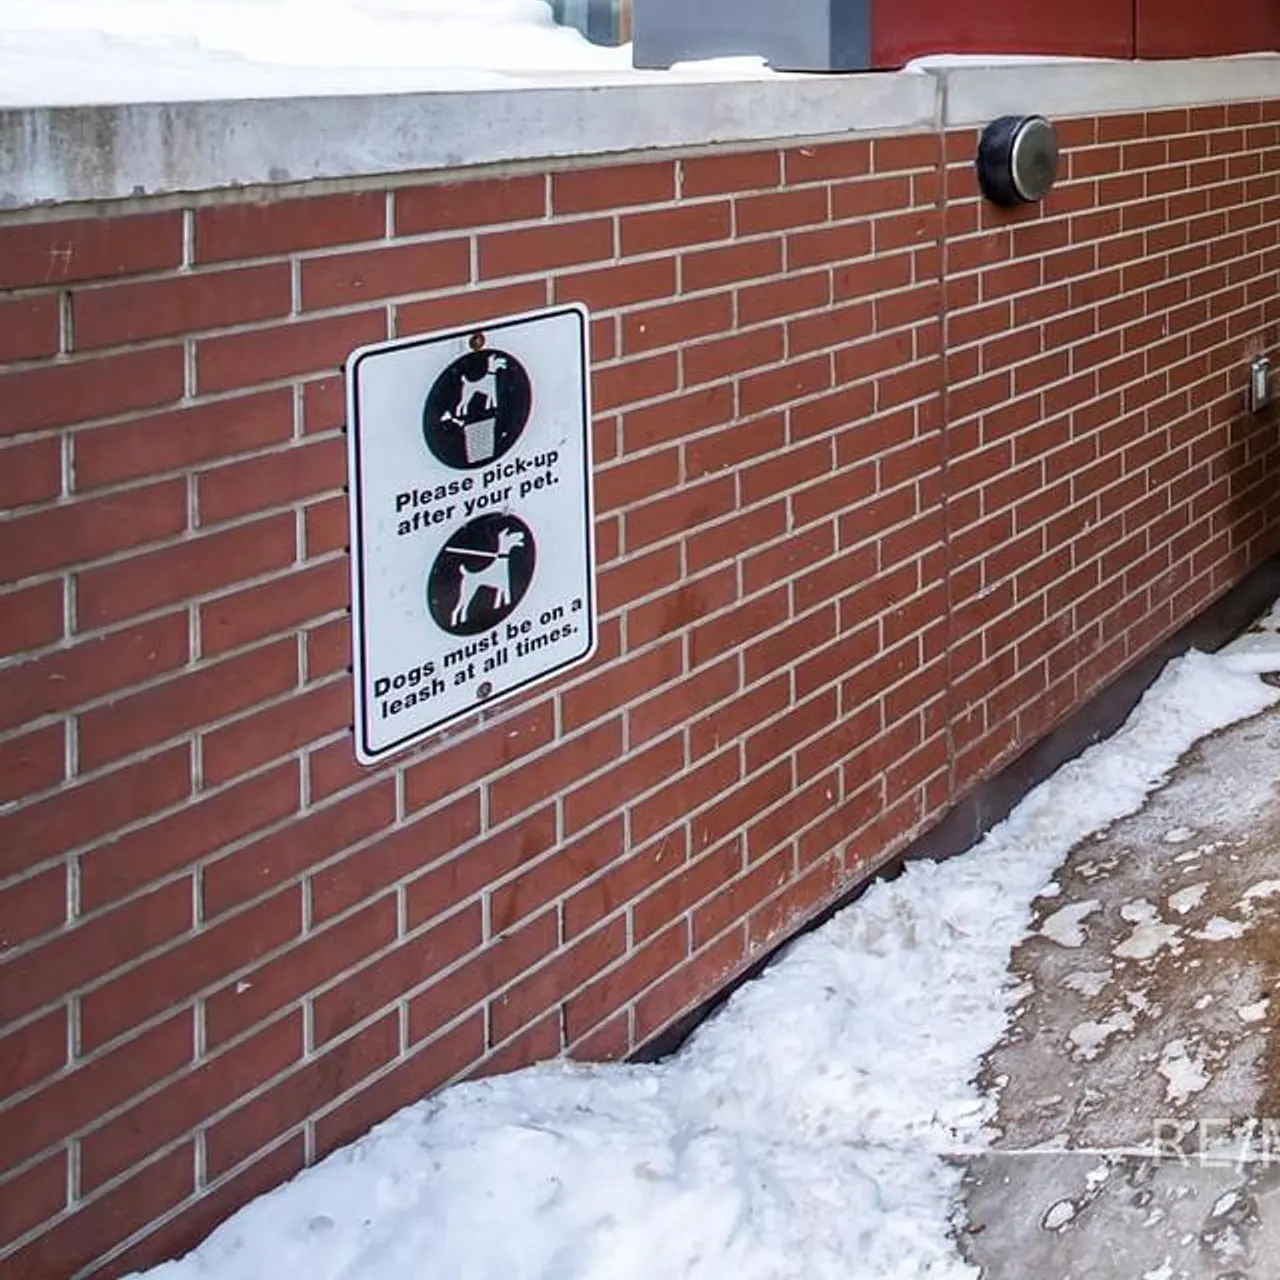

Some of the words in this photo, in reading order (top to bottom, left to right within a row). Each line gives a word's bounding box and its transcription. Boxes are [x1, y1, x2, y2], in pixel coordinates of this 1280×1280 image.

[396, 477, 474, 513] Please
[482, 450, 559, 488] pick-up
[397, 504, 456, 536] after
[463, 486, 513, 516] your
[520, 470, 559, 498] pet.
[374, 661, 435, 698] Dogs
[443, 632, 499, 668] must
[506, 619, 532, 640] be
[539, 605, 564, 625] on
[571, 597, 582, 612] a
[381, 679, 445, 719] leash
[453, 663, 475, 686] at
[483, 648, 508, 673] all
[516, 626, 578, 658] times.
